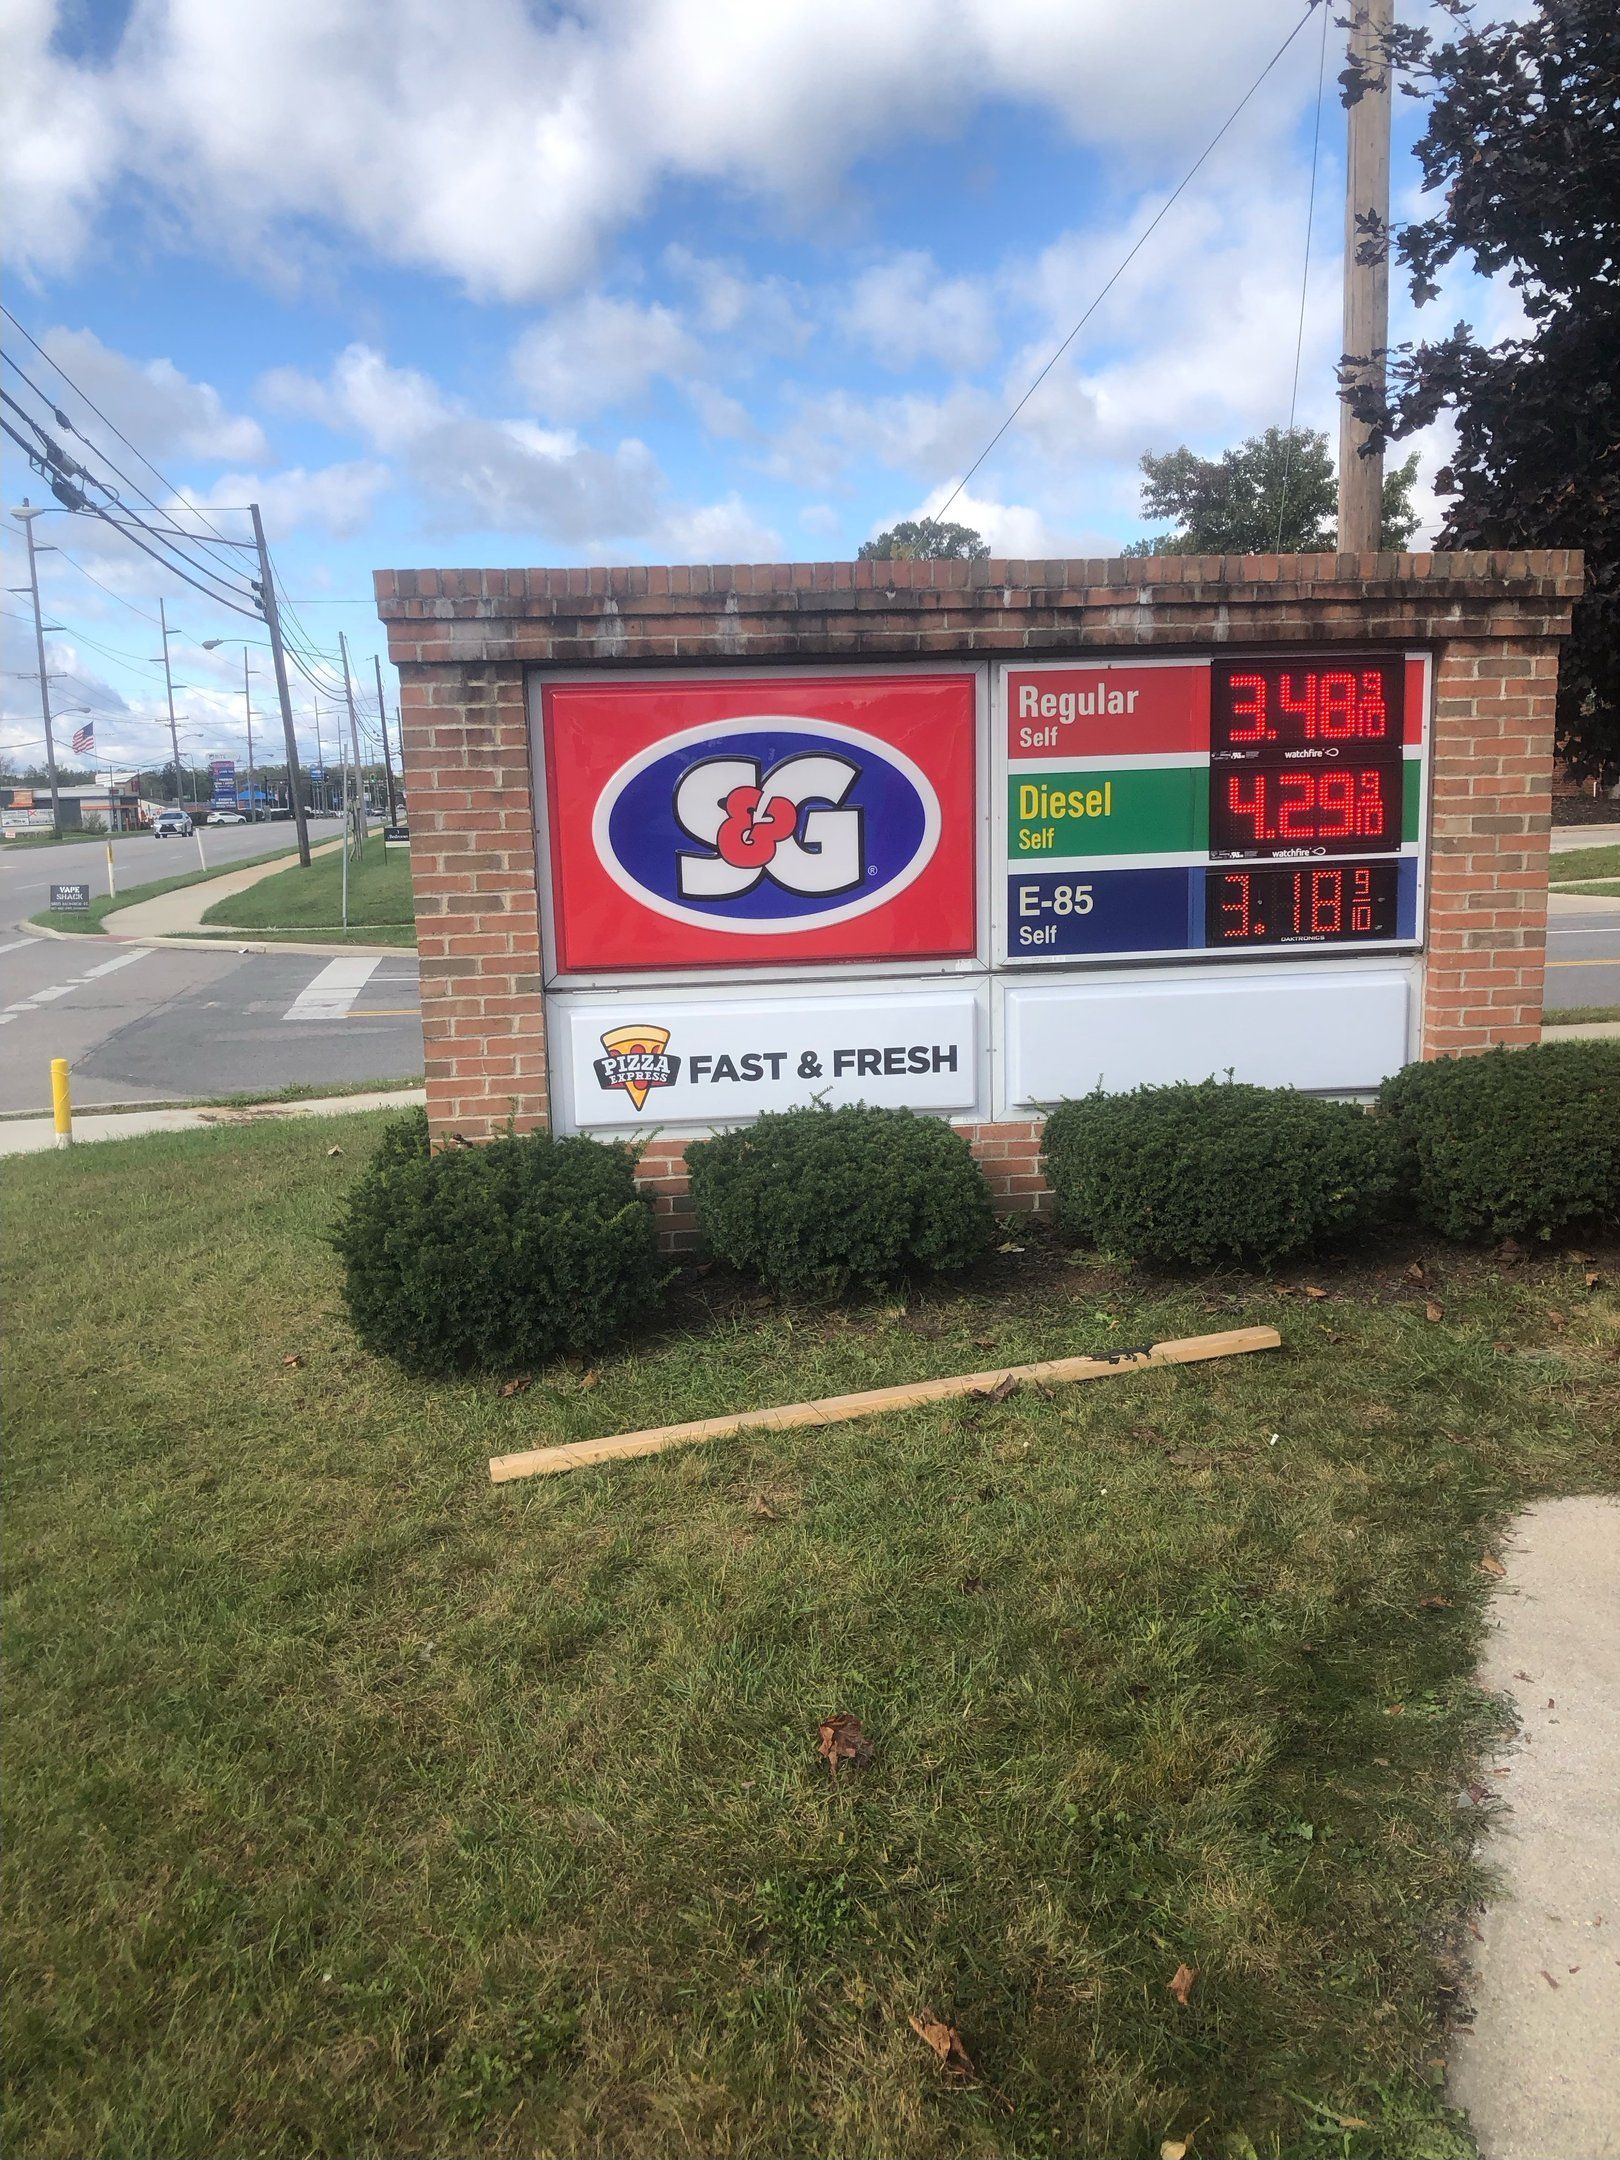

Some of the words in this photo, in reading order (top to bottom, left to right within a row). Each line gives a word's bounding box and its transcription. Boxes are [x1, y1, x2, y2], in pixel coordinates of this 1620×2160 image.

[1019, 682, 1139, 724] Regular
[1228, 672, 1356, 742] 3.48
[1019, 726, 1058, 748] Self
[1284, 748, 1323, 760] watchfire
[1019, 781, 1112, 820] Diesel
[1228, 772, 1354, 839] 4.29
[672, 750, 865, 901] S&G
[1018, 827, 1055, 850] Self
[1272, 848, 1310, 859] watchfire
[59, 886, 81, 894] VAPE
[1019, 884, 1094, 917] E-85
[1221, 870, 1343, 938] 3.18
[1019, 924, 1058, 946] Self
[601, 1054, 671, 1077] PIZZA
[609, 1071, 669, 1085] EXPRESS
[689, 1051, 788, 1084] FAST
[797, 1050, 824, 1080] &
[833, 1045, 958, 1078] FRESH
